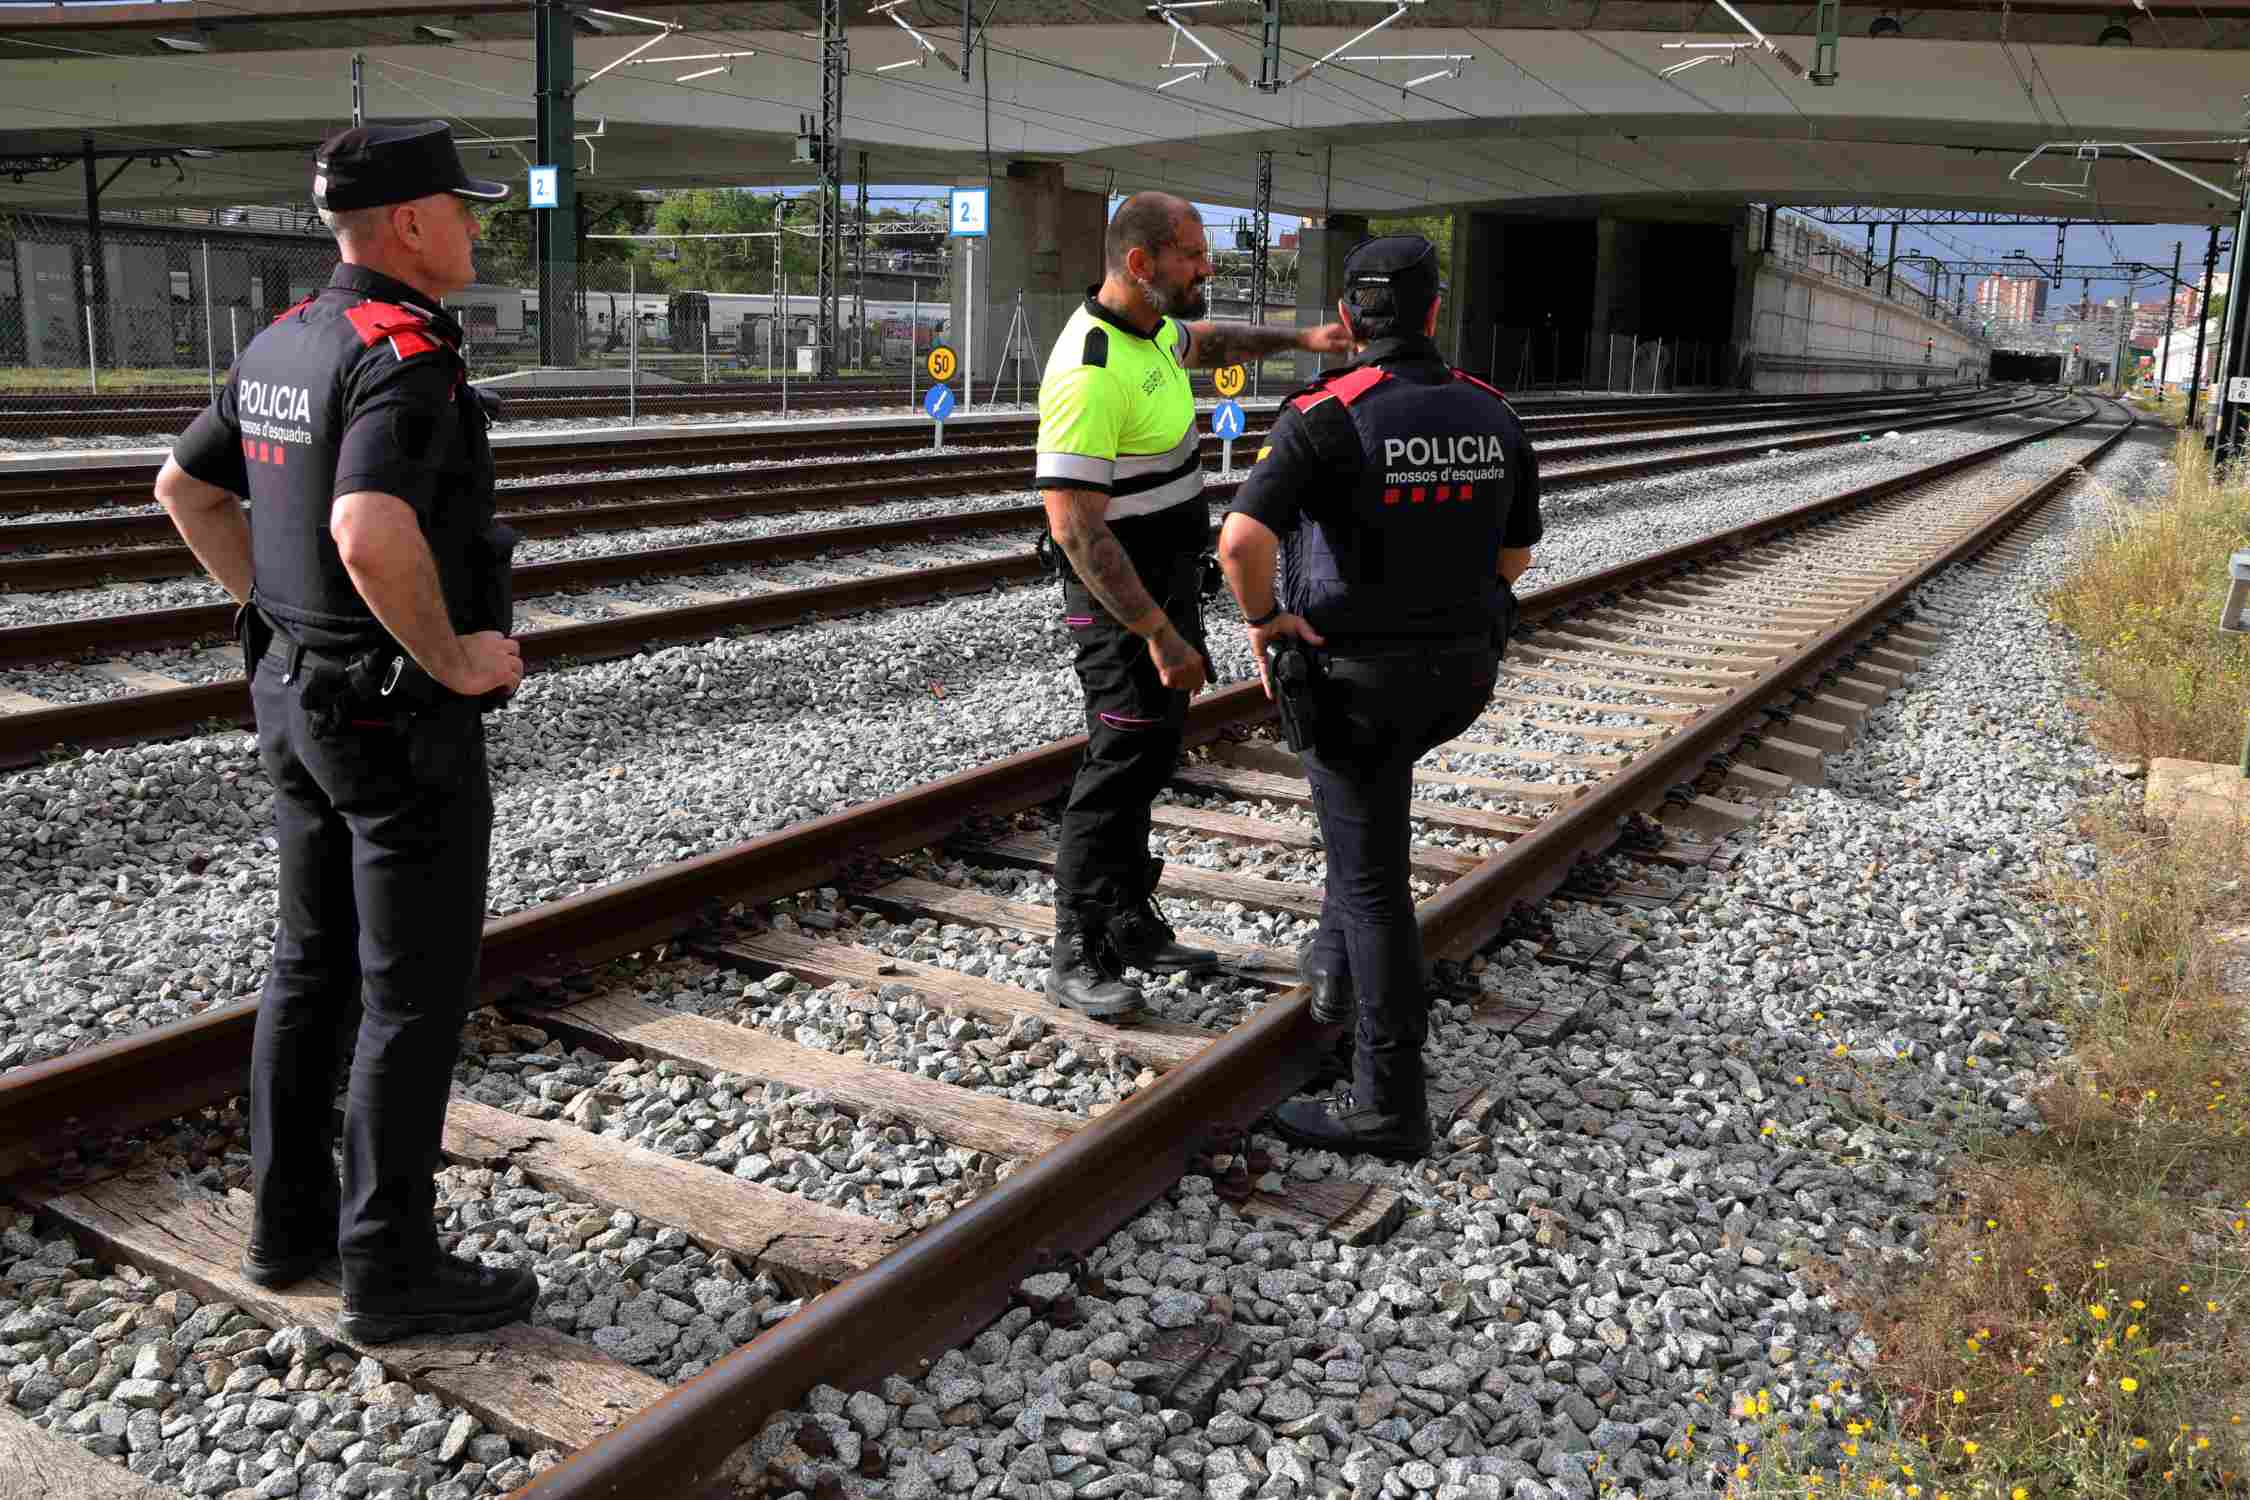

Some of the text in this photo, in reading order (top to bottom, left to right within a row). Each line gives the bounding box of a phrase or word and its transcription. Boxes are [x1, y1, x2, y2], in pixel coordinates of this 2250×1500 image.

[934, 354, 949, 373] 50
[1221, 367, 1238, 388] 50
[239, 379, 311, 423] POLICIA
[262, 420, 312, 445] d'esquadra
[1384, 436, 1504, 466] POLICIA
[1385, 465, 1504, 484] mossos d'esquadra
